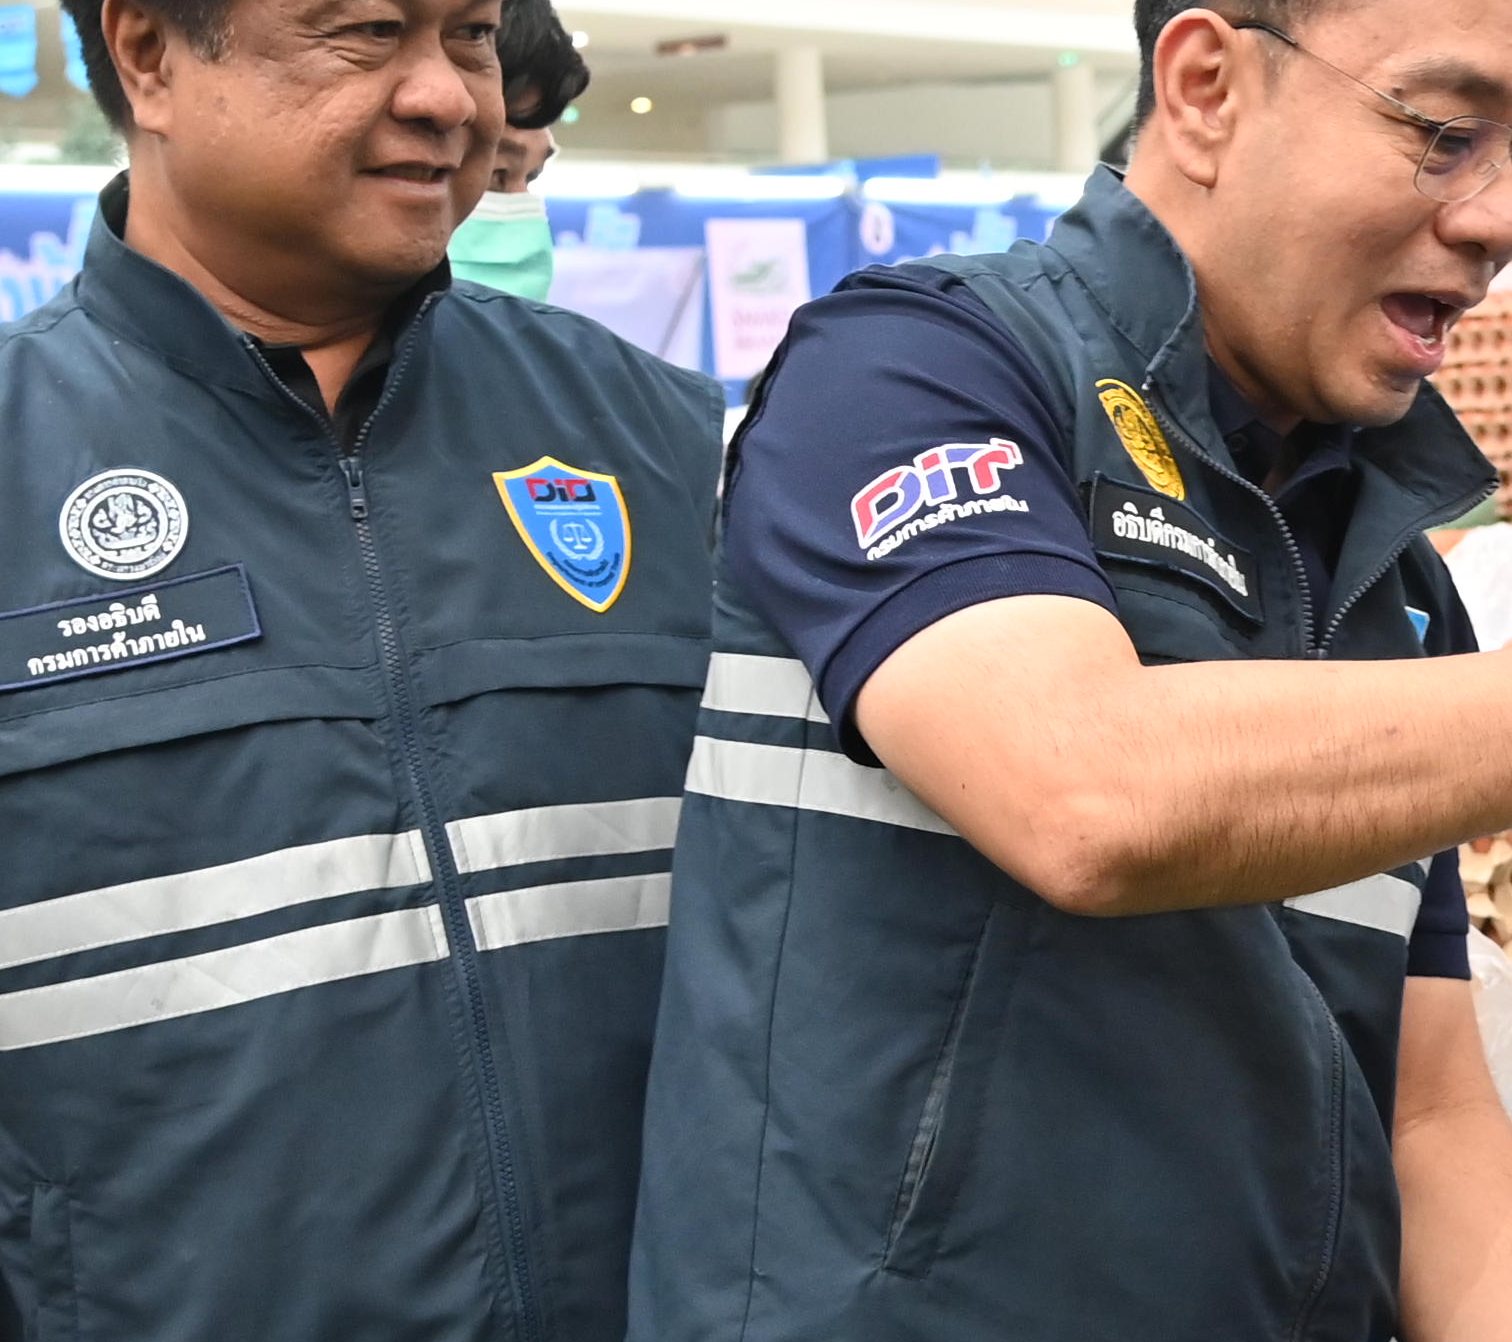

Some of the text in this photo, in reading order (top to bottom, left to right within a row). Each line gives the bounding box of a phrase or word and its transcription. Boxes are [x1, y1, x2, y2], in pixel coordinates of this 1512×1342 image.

[867, 494, 1030, 561] กรมการค้าภายใน
[57, 593, 162, 639] รองอธิบดี
[26, 619, 207, 676] กรมการค้าภายใน
